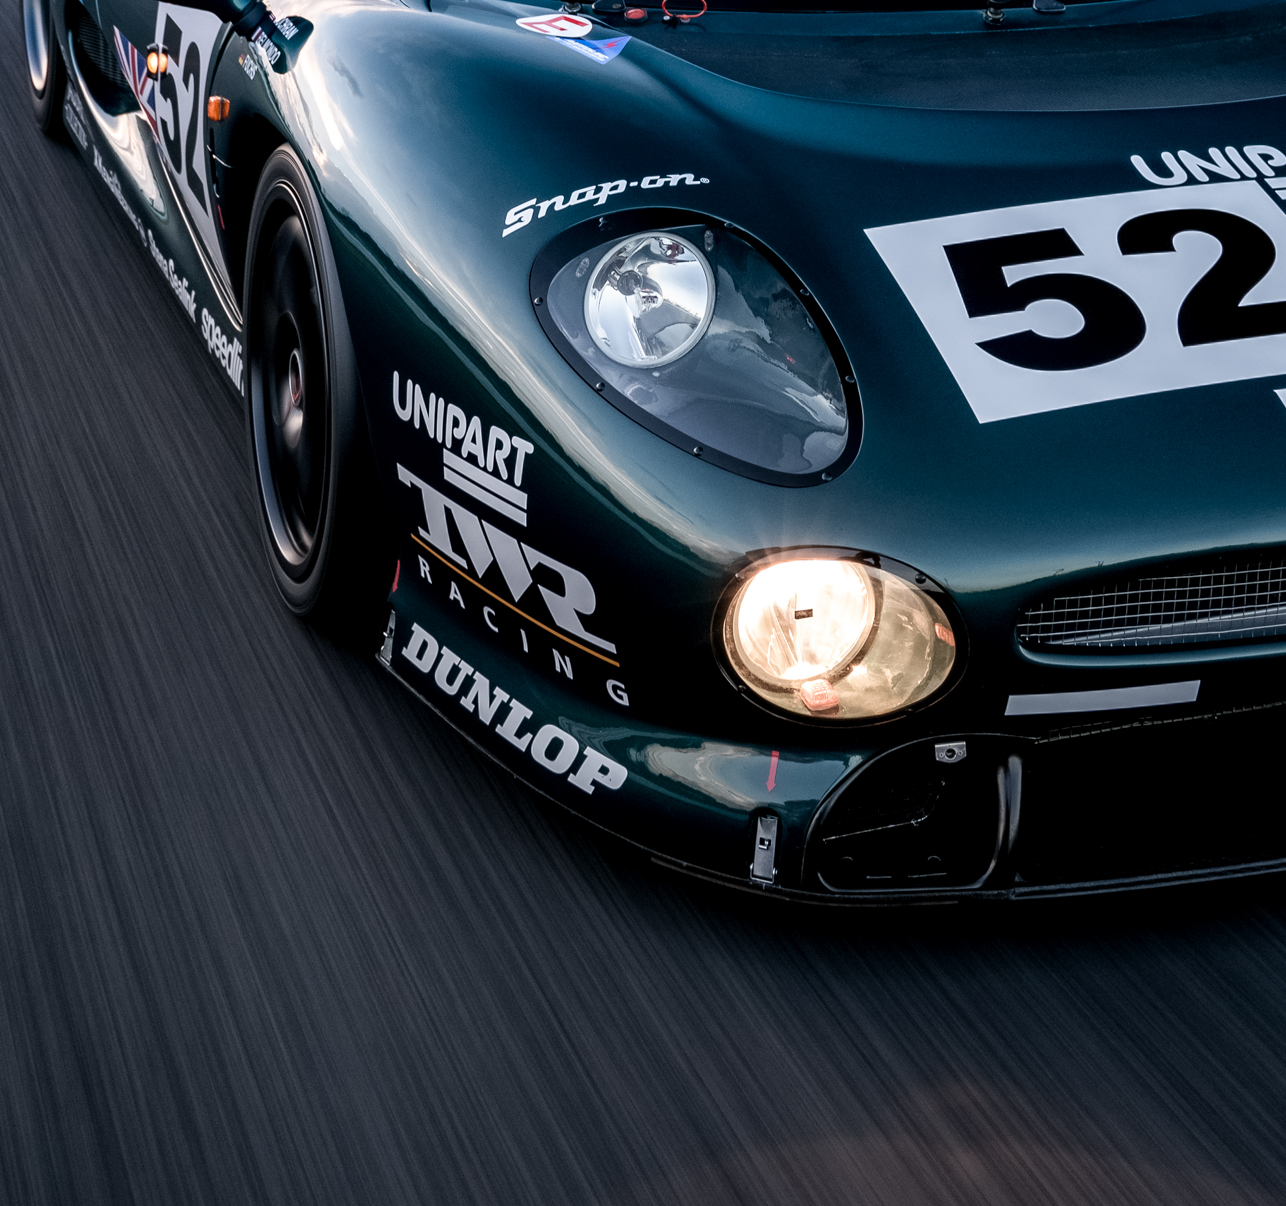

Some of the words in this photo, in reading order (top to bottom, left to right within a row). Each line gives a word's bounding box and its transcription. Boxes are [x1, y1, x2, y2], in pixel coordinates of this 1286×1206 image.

[159, 13, 210, 218] 52
[393, 370, 534, 487] UNIPART
[397, 462, 617, 654] TWR
[417, 554, 630, 707] RACING
[401, 622, 629, 795] DUNLOP
